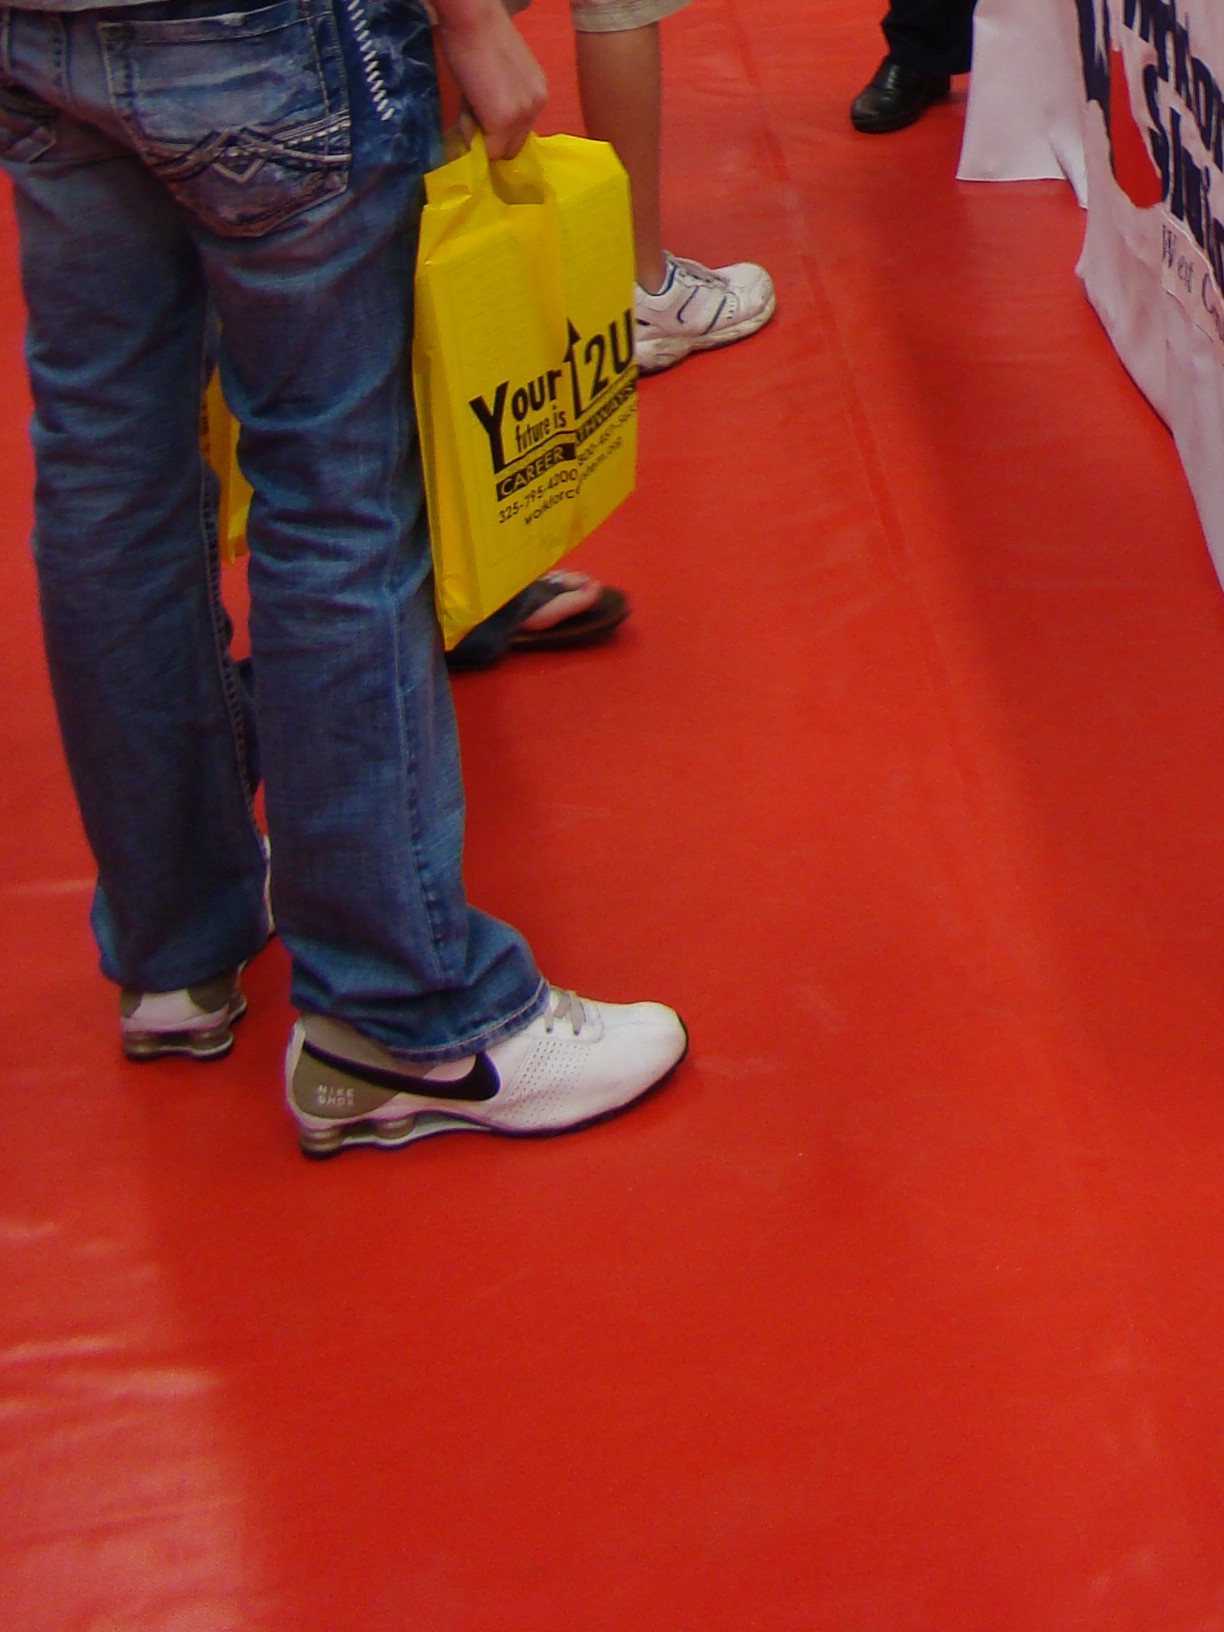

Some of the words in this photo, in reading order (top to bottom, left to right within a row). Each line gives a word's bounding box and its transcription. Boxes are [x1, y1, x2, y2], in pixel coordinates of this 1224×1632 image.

[468, 369, 562, 474] Your
[515, 417, 551, 454] future
[552, 404, 568, 429] is
[501, 445, 566, 497] CAREER
[318, 1084, 354, 1097] NIKE
